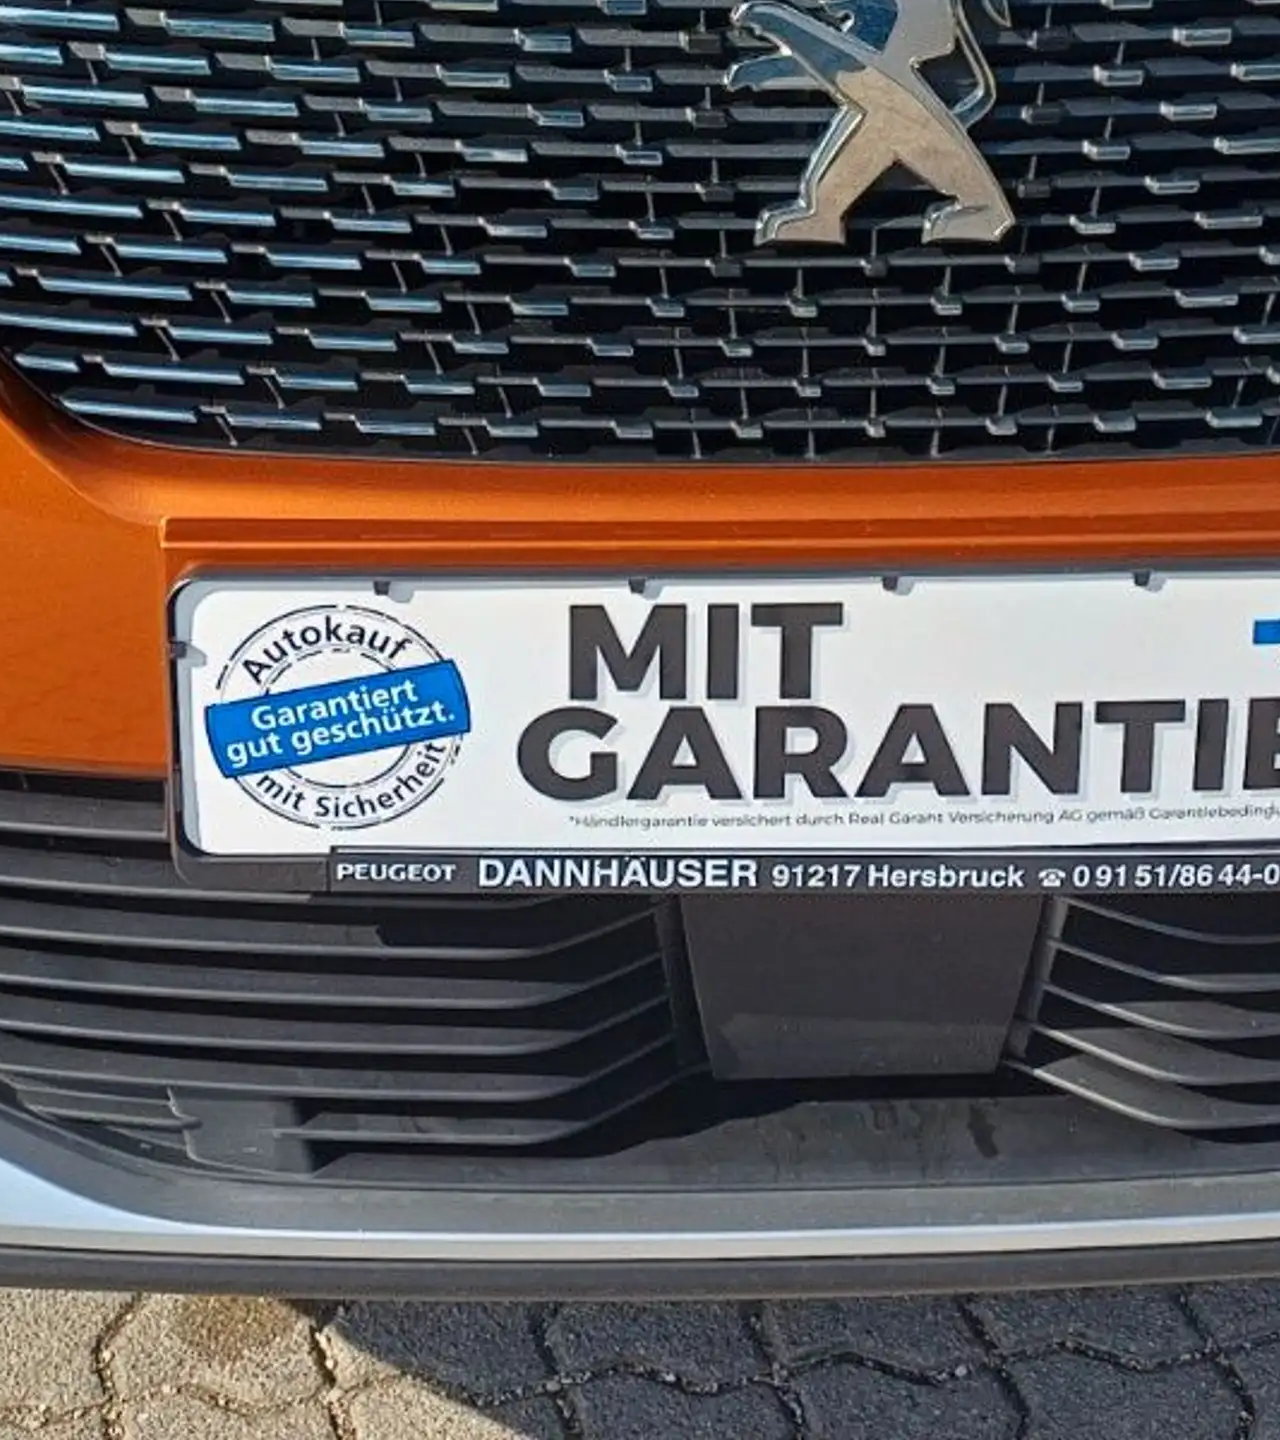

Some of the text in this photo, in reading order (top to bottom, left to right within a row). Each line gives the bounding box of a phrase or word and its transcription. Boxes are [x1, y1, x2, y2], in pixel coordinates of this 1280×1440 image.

[242, 614, 413, 685] Autokauf
[568, 601, 845, 701] MIT
[226, 700, 455, 768] gut geschützt.
[251, 679, 418, 730] Garantiert
[256, 741, 445, 819] mit Sicherheit
[711, 813, 791, 828] versichert
[795, 812, 844, 827] durch
[848, 812, 884, 826] Real
[888, 812, 944, 826] Garant
[950, 810, 1054, 827] Versicherung
[1058, 809, 1083, 822] AG
[336, 863, 457, 882] PEUGEOT
[478, 855, 758, 889] DANNHÄUSER
[771, 863, 862, 889] 91217
[867, 863, 1025, 889] Hersbruck
